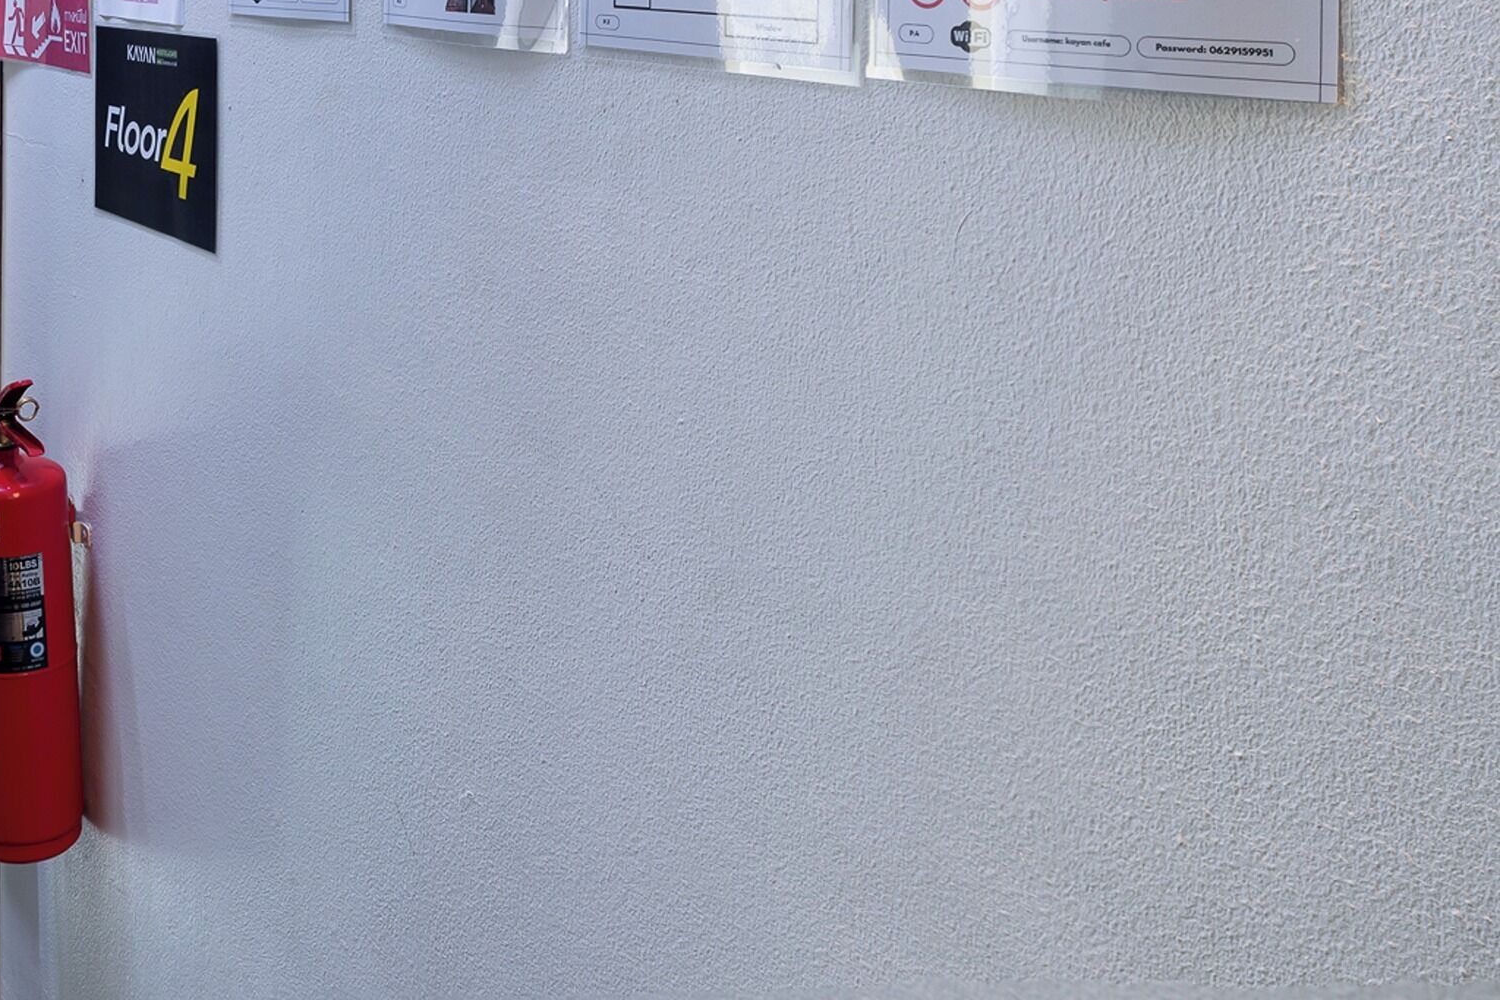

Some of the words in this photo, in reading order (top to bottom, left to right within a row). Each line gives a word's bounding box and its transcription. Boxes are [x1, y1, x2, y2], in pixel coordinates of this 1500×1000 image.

[64, 29, 87, 55] EXIT
[1156, 43, 1207, 53] Password:
[1209, 46, 1274, 57] 0629159951
[126, 44, 156, 65] KAYAN
[105, 105, 167, 162] Floor
[161, 88, 199, 200] 4
